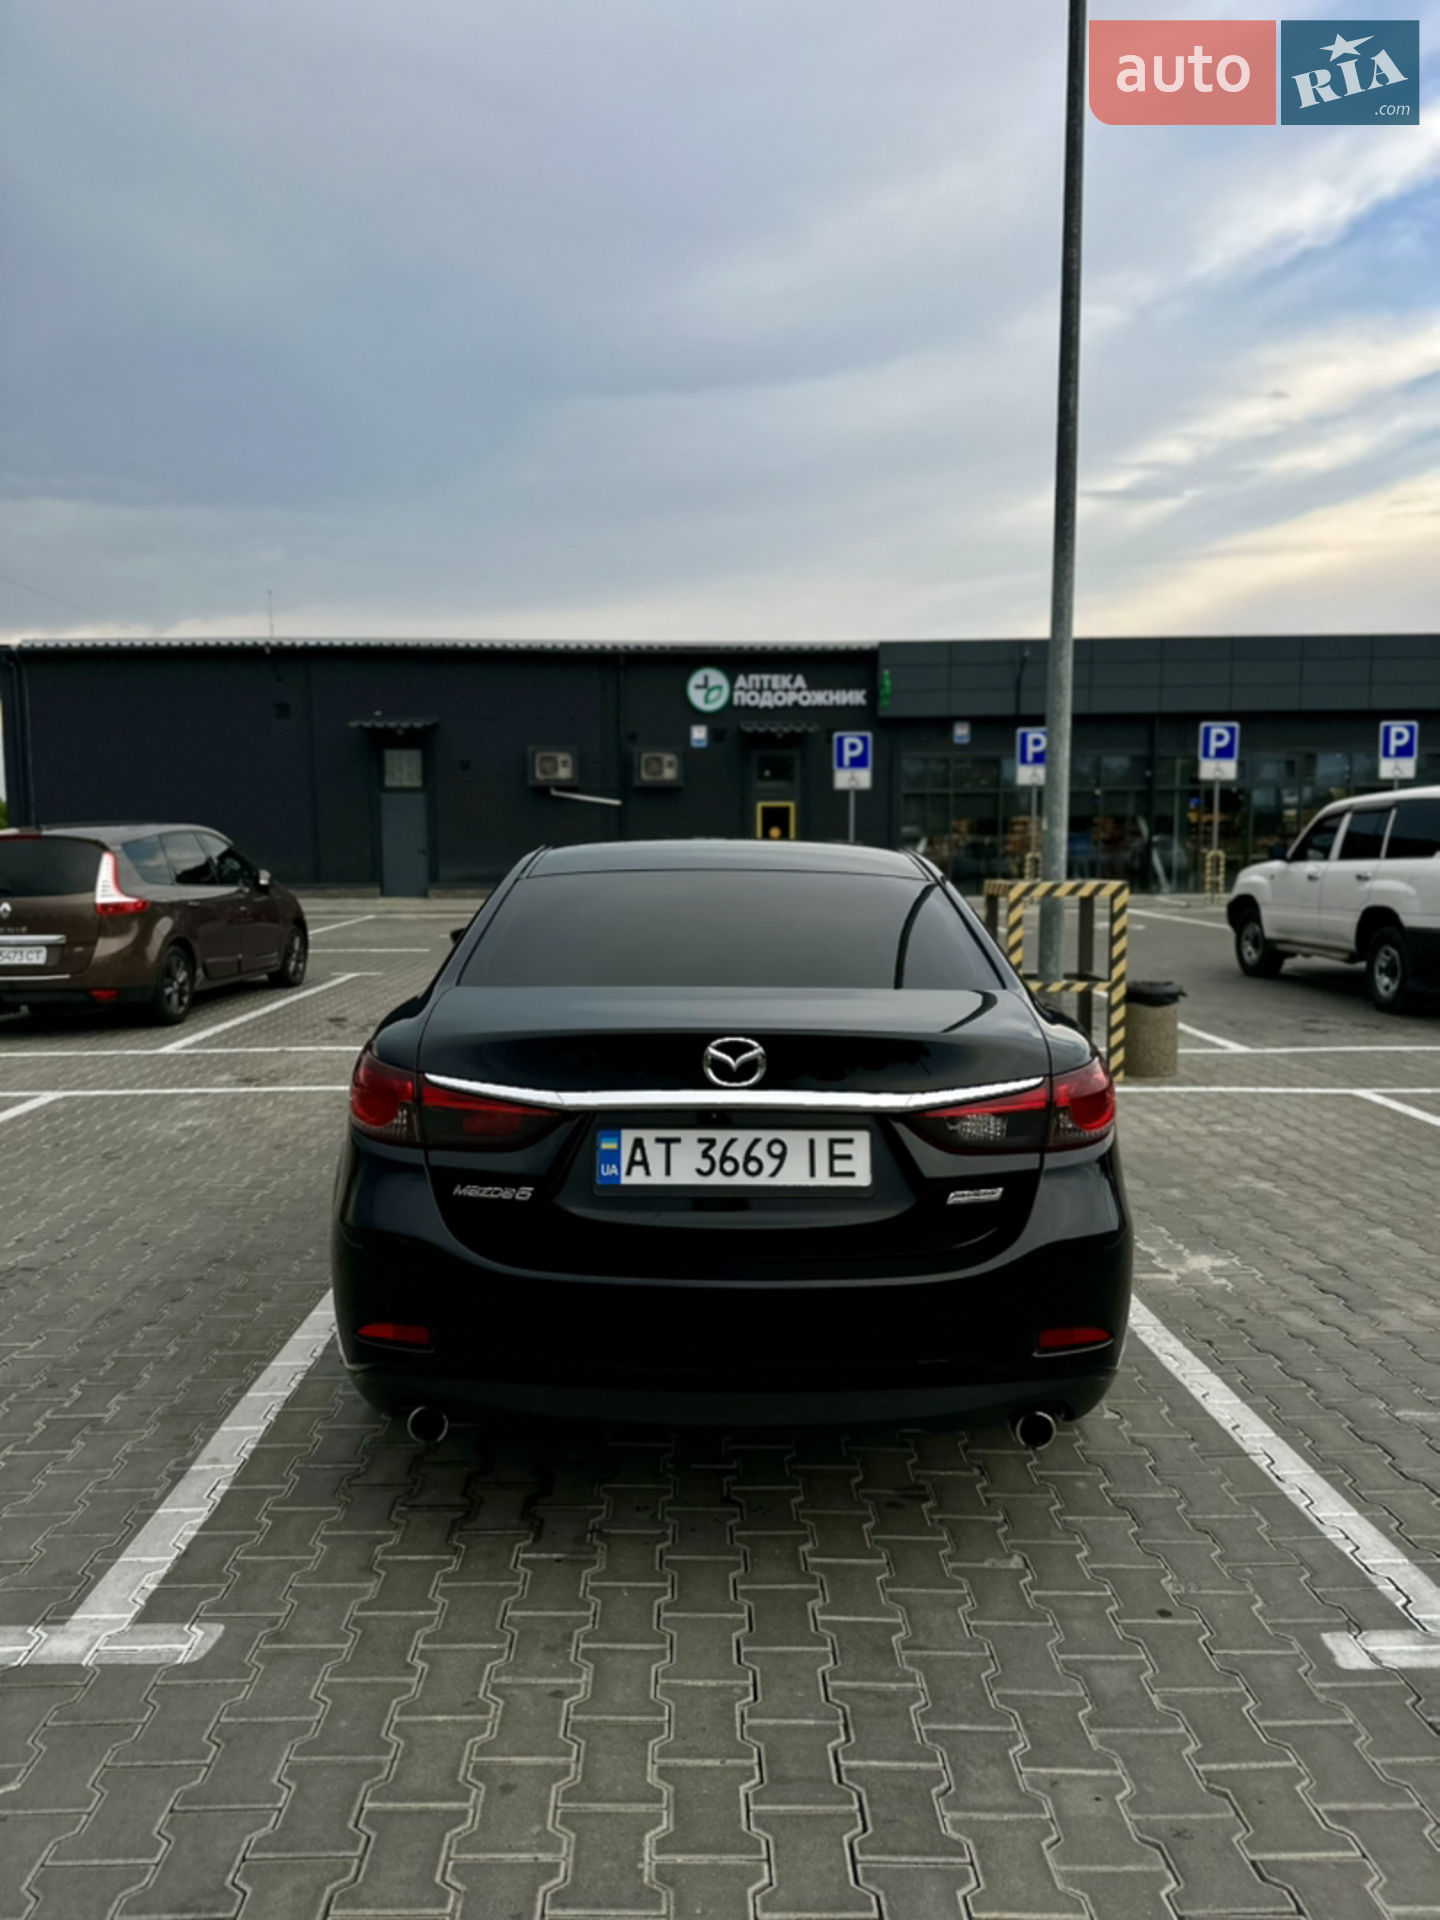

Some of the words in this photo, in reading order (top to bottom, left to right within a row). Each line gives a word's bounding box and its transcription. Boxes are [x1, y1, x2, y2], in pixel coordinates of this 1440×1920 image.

[734, 673, 807, 690] АПТЕКА
[733, 690, 867, 709] ПОДОРОЖНИК
[843, 736, 864, 767] P
[1026, 732, 1047, 763] P
[1209, 727, 1231, 757] P
[1389, 726, 1411, 757] P
[600, 1163, 619, 1176] UA
[625, 1136, 682, 1177] AT
[695, 1137, 788, 1178] 3669
[808, 1137, 856, 1178] IE
